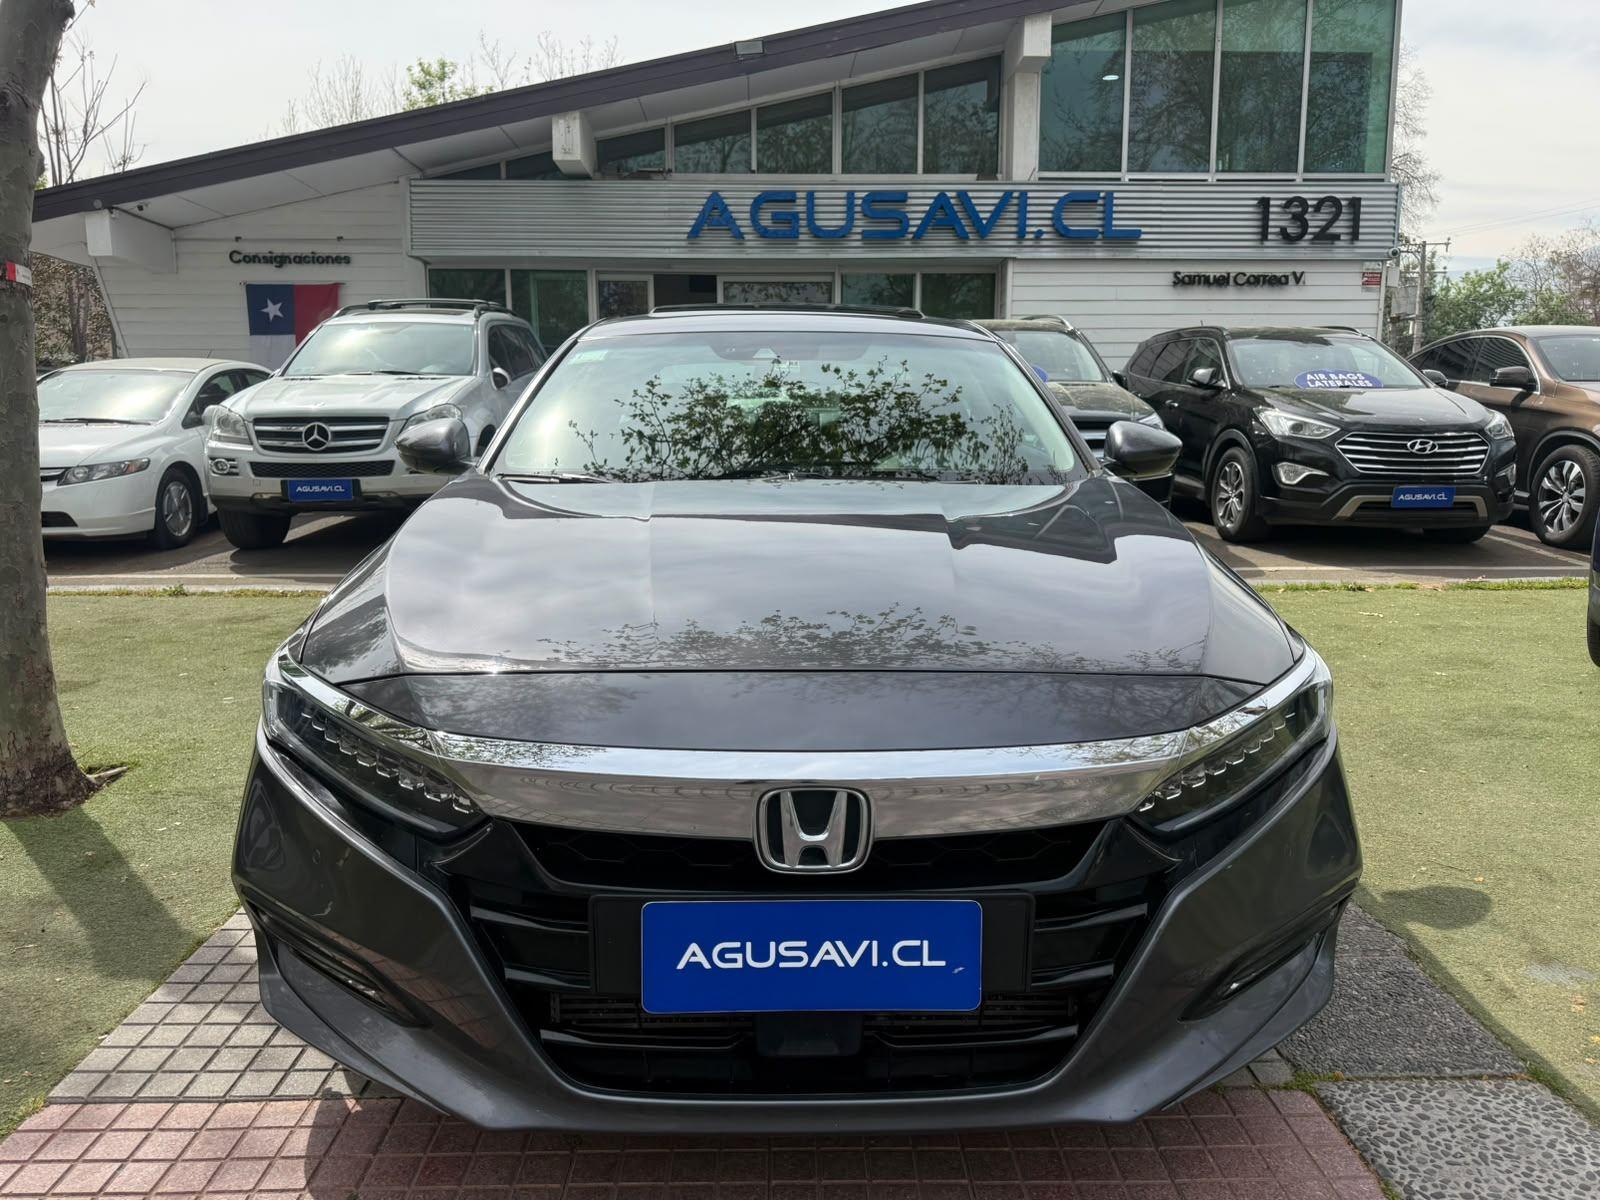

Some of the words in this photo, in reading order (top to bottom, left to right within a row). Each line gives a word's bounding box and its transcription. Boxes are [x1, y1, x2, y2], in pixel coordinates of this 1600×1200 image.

[686, 190, 1142, 242] AGUSAVI.CL
[1256, 195, 1362, 243] 1321
[229, 249, 351, 269] Consignaciones
[1172, 271, 1230, 287] Samuel
[1233, 271, 1289, 287] Correa
[1306, 373, 1328, 381] AIR
[1329, 373, 1365, 381] BAGS
[1306, 379, 1373, 388] LATERALES
[296, 485, 345, 493] AGUSAVI.CL
[1398, 492, 1448, 501] AGUSAVI.CL
[676, 939, 947, 970] AGUSAVI.CL
